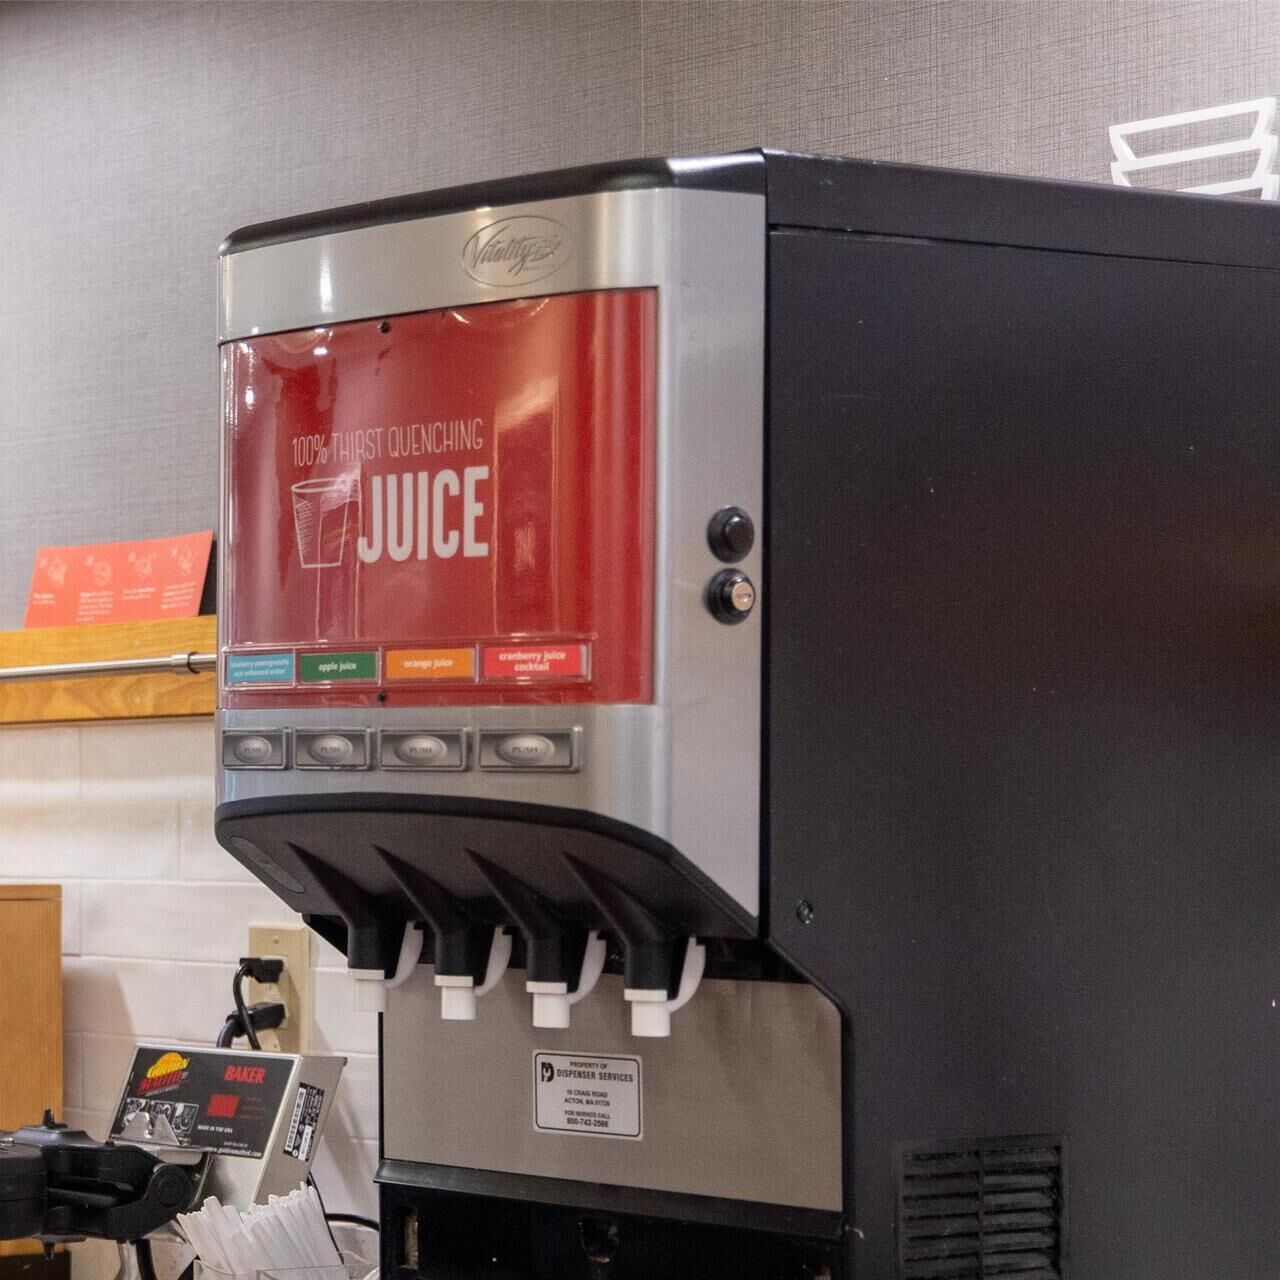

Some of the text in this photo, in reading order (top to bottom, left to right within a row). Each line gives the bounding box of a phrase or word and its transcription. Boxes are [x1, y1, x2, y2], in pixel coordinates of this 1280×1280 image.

[292, 418, 484, 467] 100% THIRST QUENCHING
[357, 465, 490, 564] JUICE
[499, 650, 566, 662] cranberry juice
[318, 661, 357, 672] apple juice
[403, 658, 453, 669] orange juice
[514, 661, 550, 672] cocktail
[569, 1061, 599, 1069] PROPERTY
[224, 1064, 266, 1084] BAKER
[556, 1069, 634, 1082] DISPENSER SERVICES
